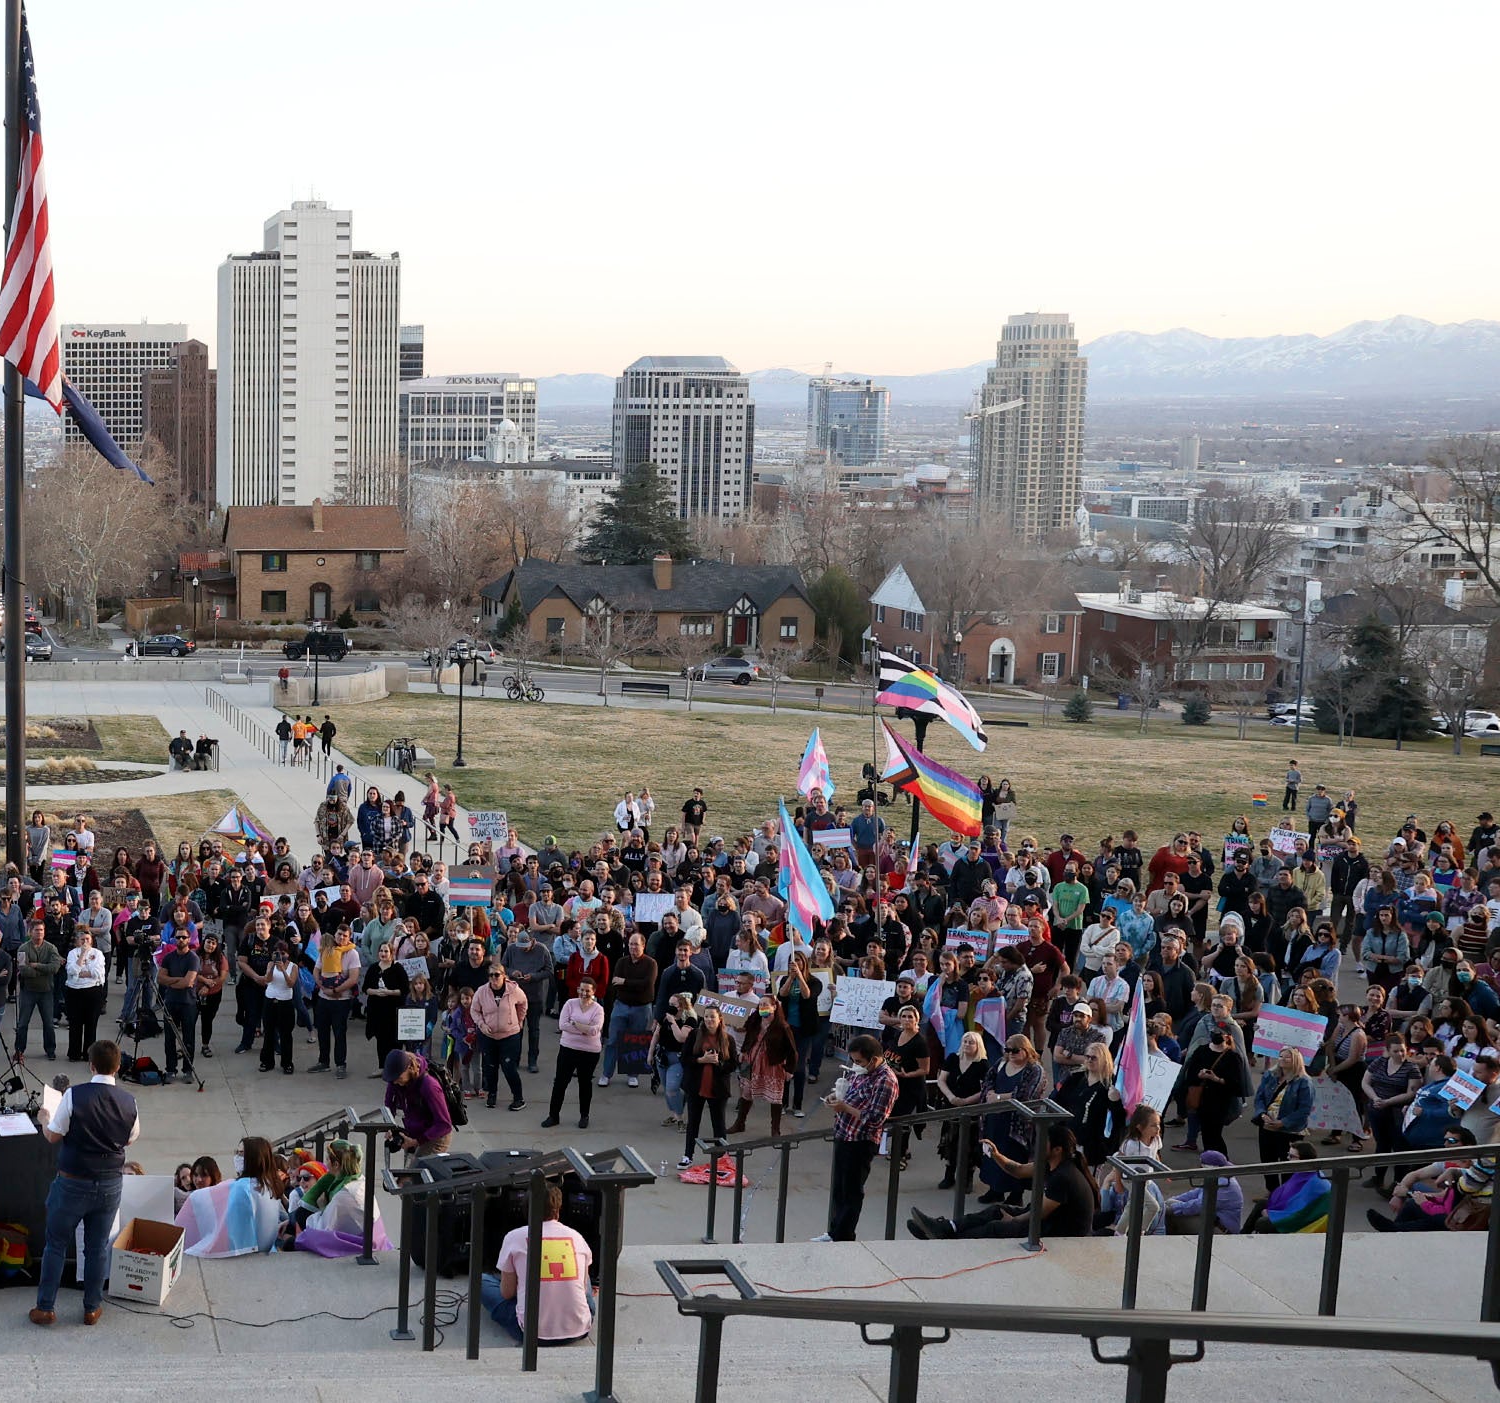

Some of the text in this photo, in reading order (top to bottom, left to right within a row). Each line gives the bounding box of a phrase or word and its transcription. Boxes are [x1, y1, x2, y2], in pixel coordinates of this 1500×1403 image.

[87, 330, 127, 340] KeyBank
[446, 377, 500, 385] ZIONS BANK
[469, 827, 508, 838] TRANS KIDS
[624, 852, 645, 861] ALLY
[947, 930, 970, 939] TRANS
[720, 1000, 747, 1018] THEM
